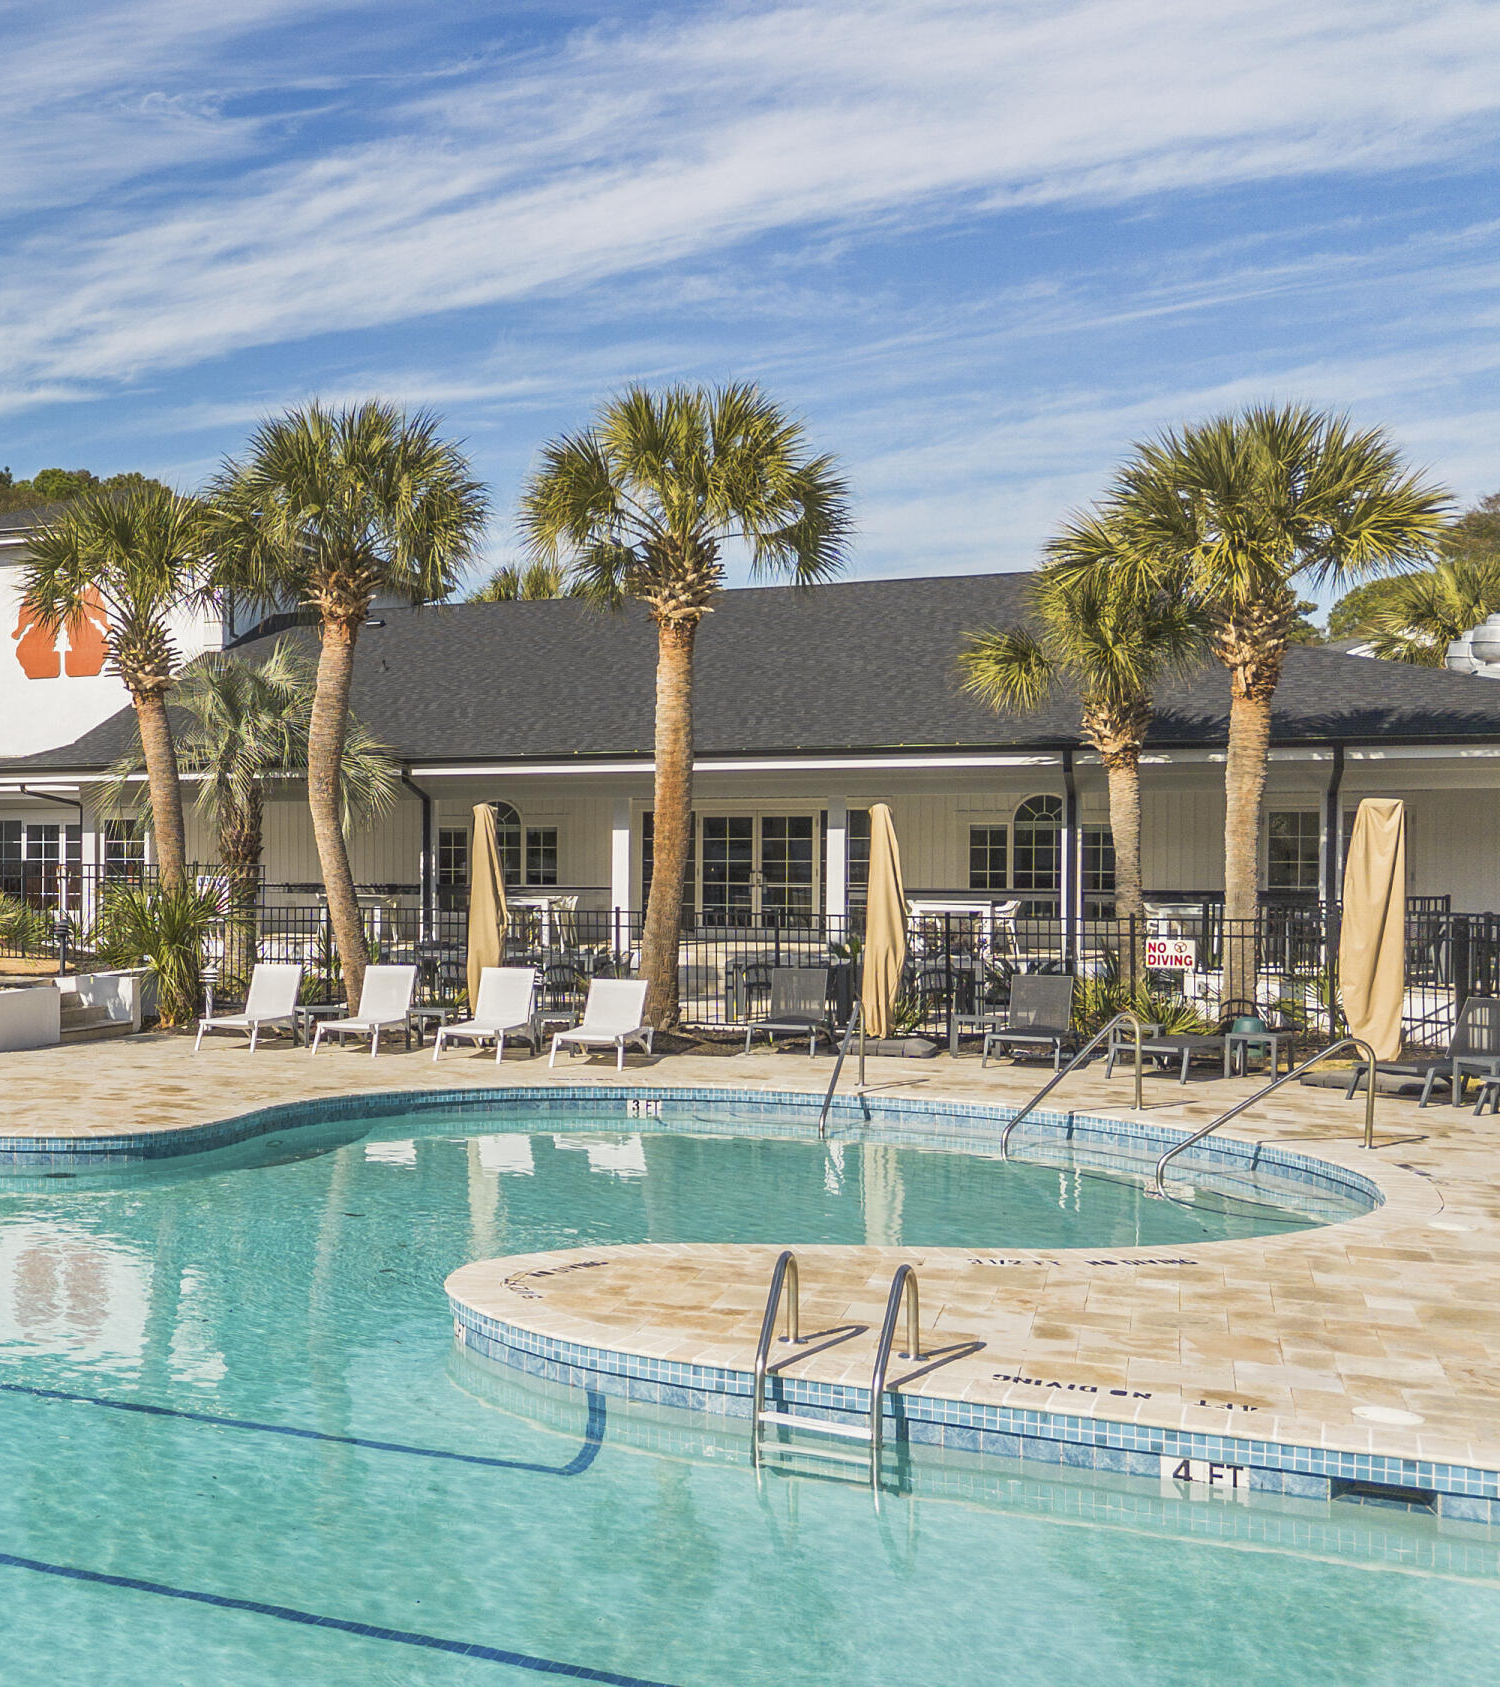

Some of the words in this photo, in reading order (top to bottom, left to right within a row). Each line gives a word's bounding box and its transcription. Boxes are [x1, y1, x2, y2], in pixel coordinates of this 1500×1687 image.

[1148, 942, 1166, 953] NO
[1148, 955, 1193, 966] DIVING
[632, 1100, 640, 1111] 3
[646, 1100, 659, 1113] FT
[992, 1374, 1098, 1393] DIVING
[1173, 1460, 1193, 1481] 4
[1209, 1462, 1244, 1488] FT
